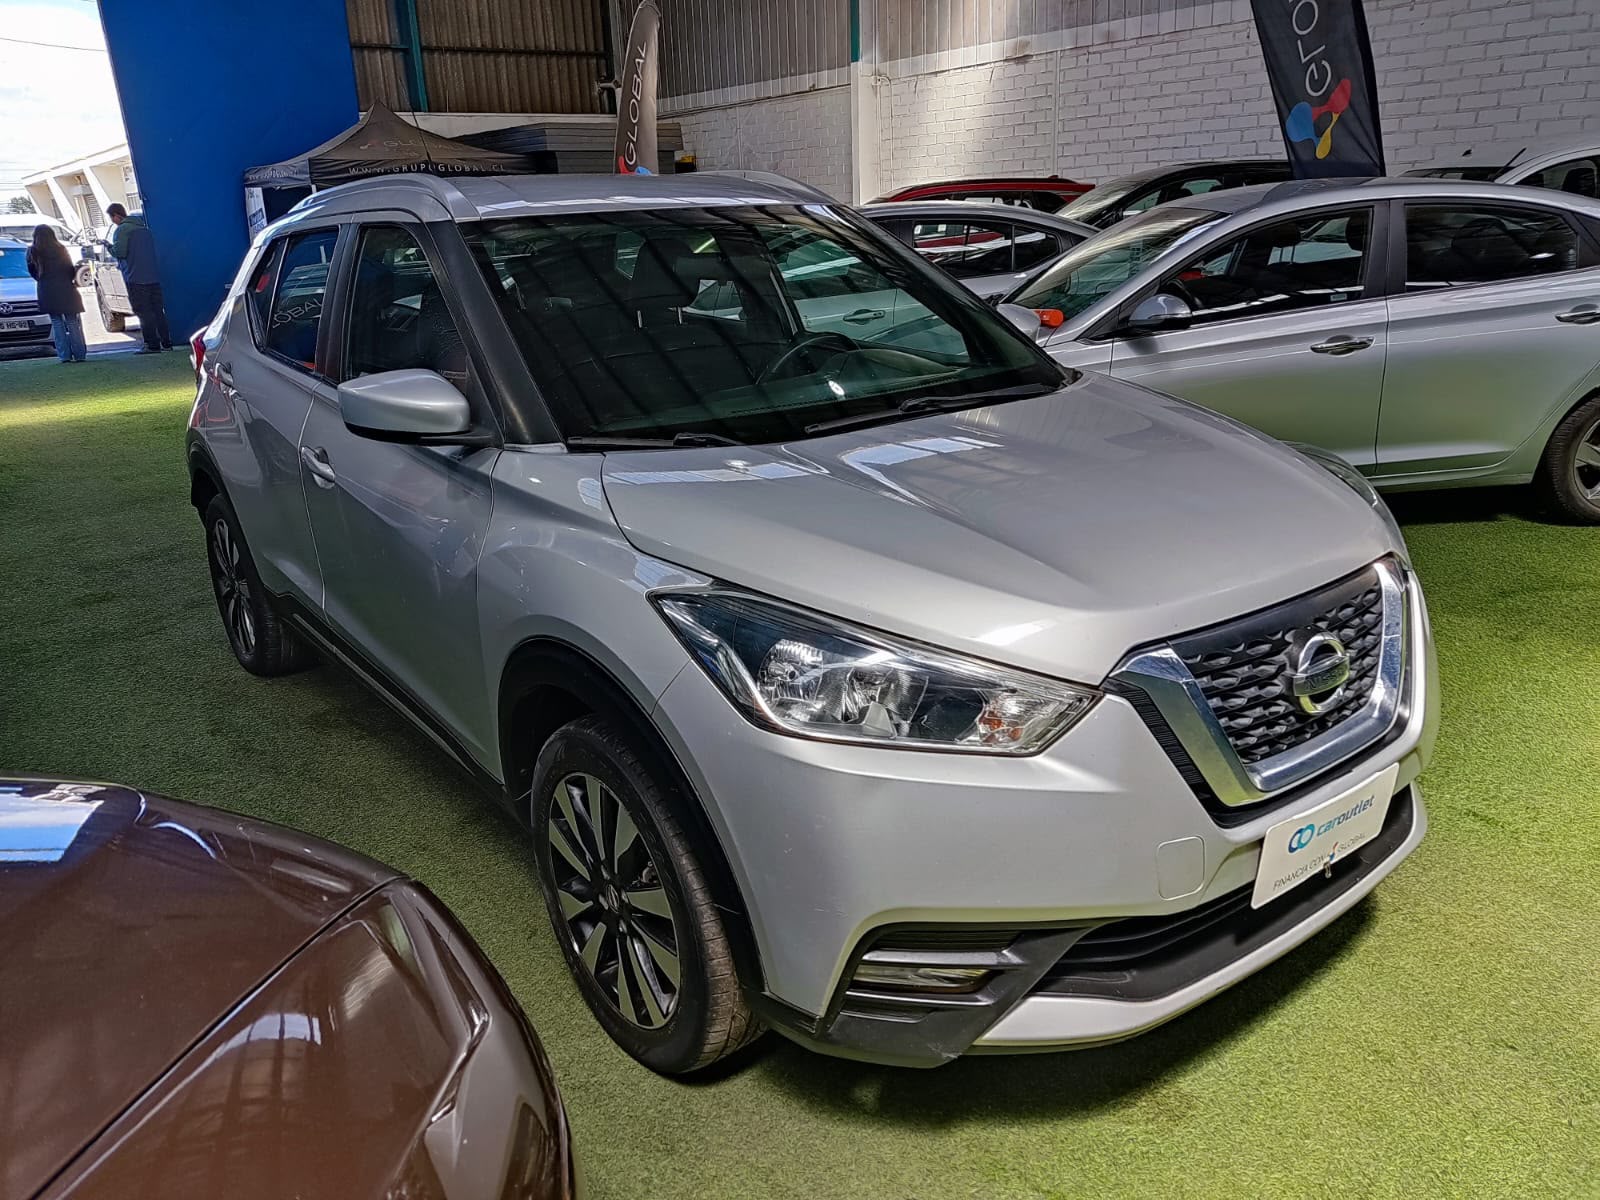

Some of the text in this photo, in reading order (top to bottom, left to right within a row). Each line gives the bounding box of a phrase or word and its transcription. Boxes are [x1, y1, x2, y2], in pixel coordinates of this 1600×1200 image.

[1289, 0, 1331, 97] GLO
[624, 41, 647, 166] GLOBAL
[1304, 665, 1346, 692] NISS
[1316, 795, 1375, 837] caroutlet
